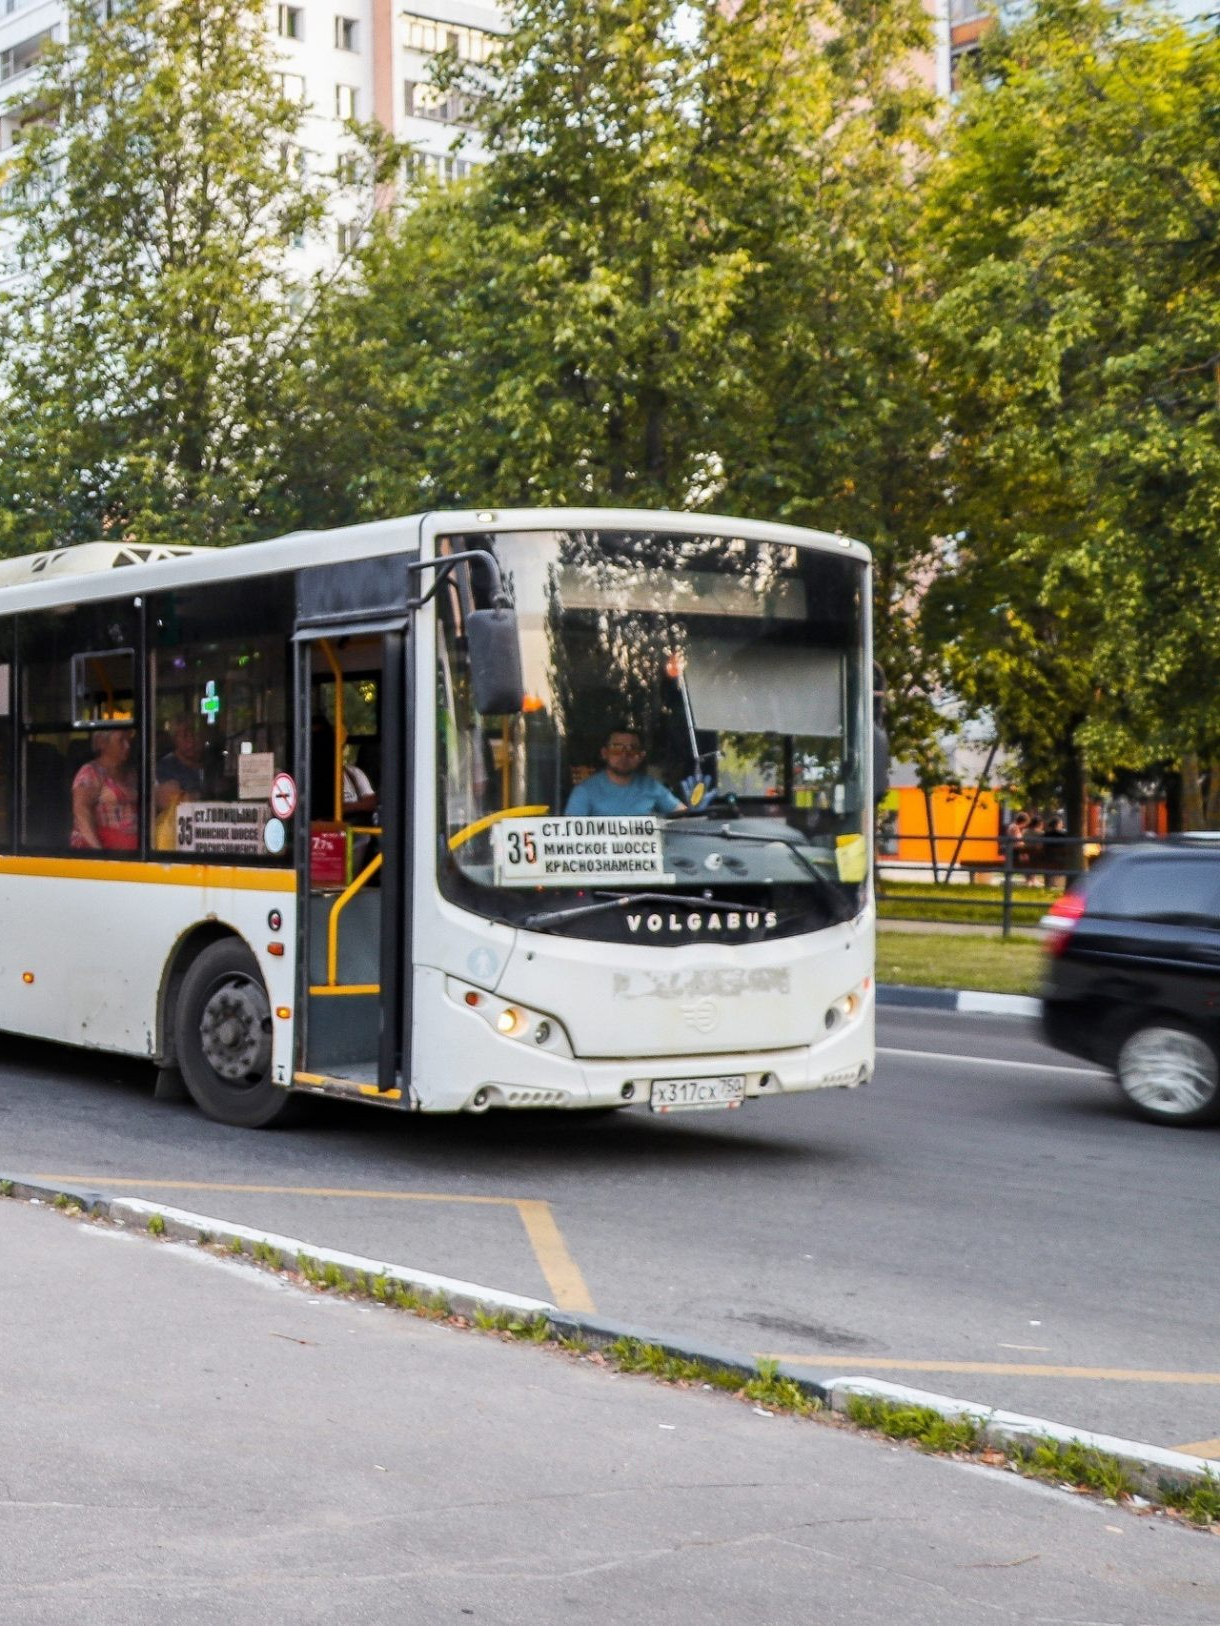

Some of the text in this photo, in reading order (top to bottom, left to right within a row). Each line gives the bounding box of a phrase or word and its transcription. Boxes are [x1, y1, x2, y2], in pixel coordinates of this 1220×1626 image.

[178, 816, 193, 845] 35
[508, 832, 537, 864] 35
[544, 841, 656, 855] МИНСКОЕ ШОССЕ
[545, 859, 657, 873] КРАСНОЗНАМЕНСК
[626, 911, 778, 932] VOLGABUS
